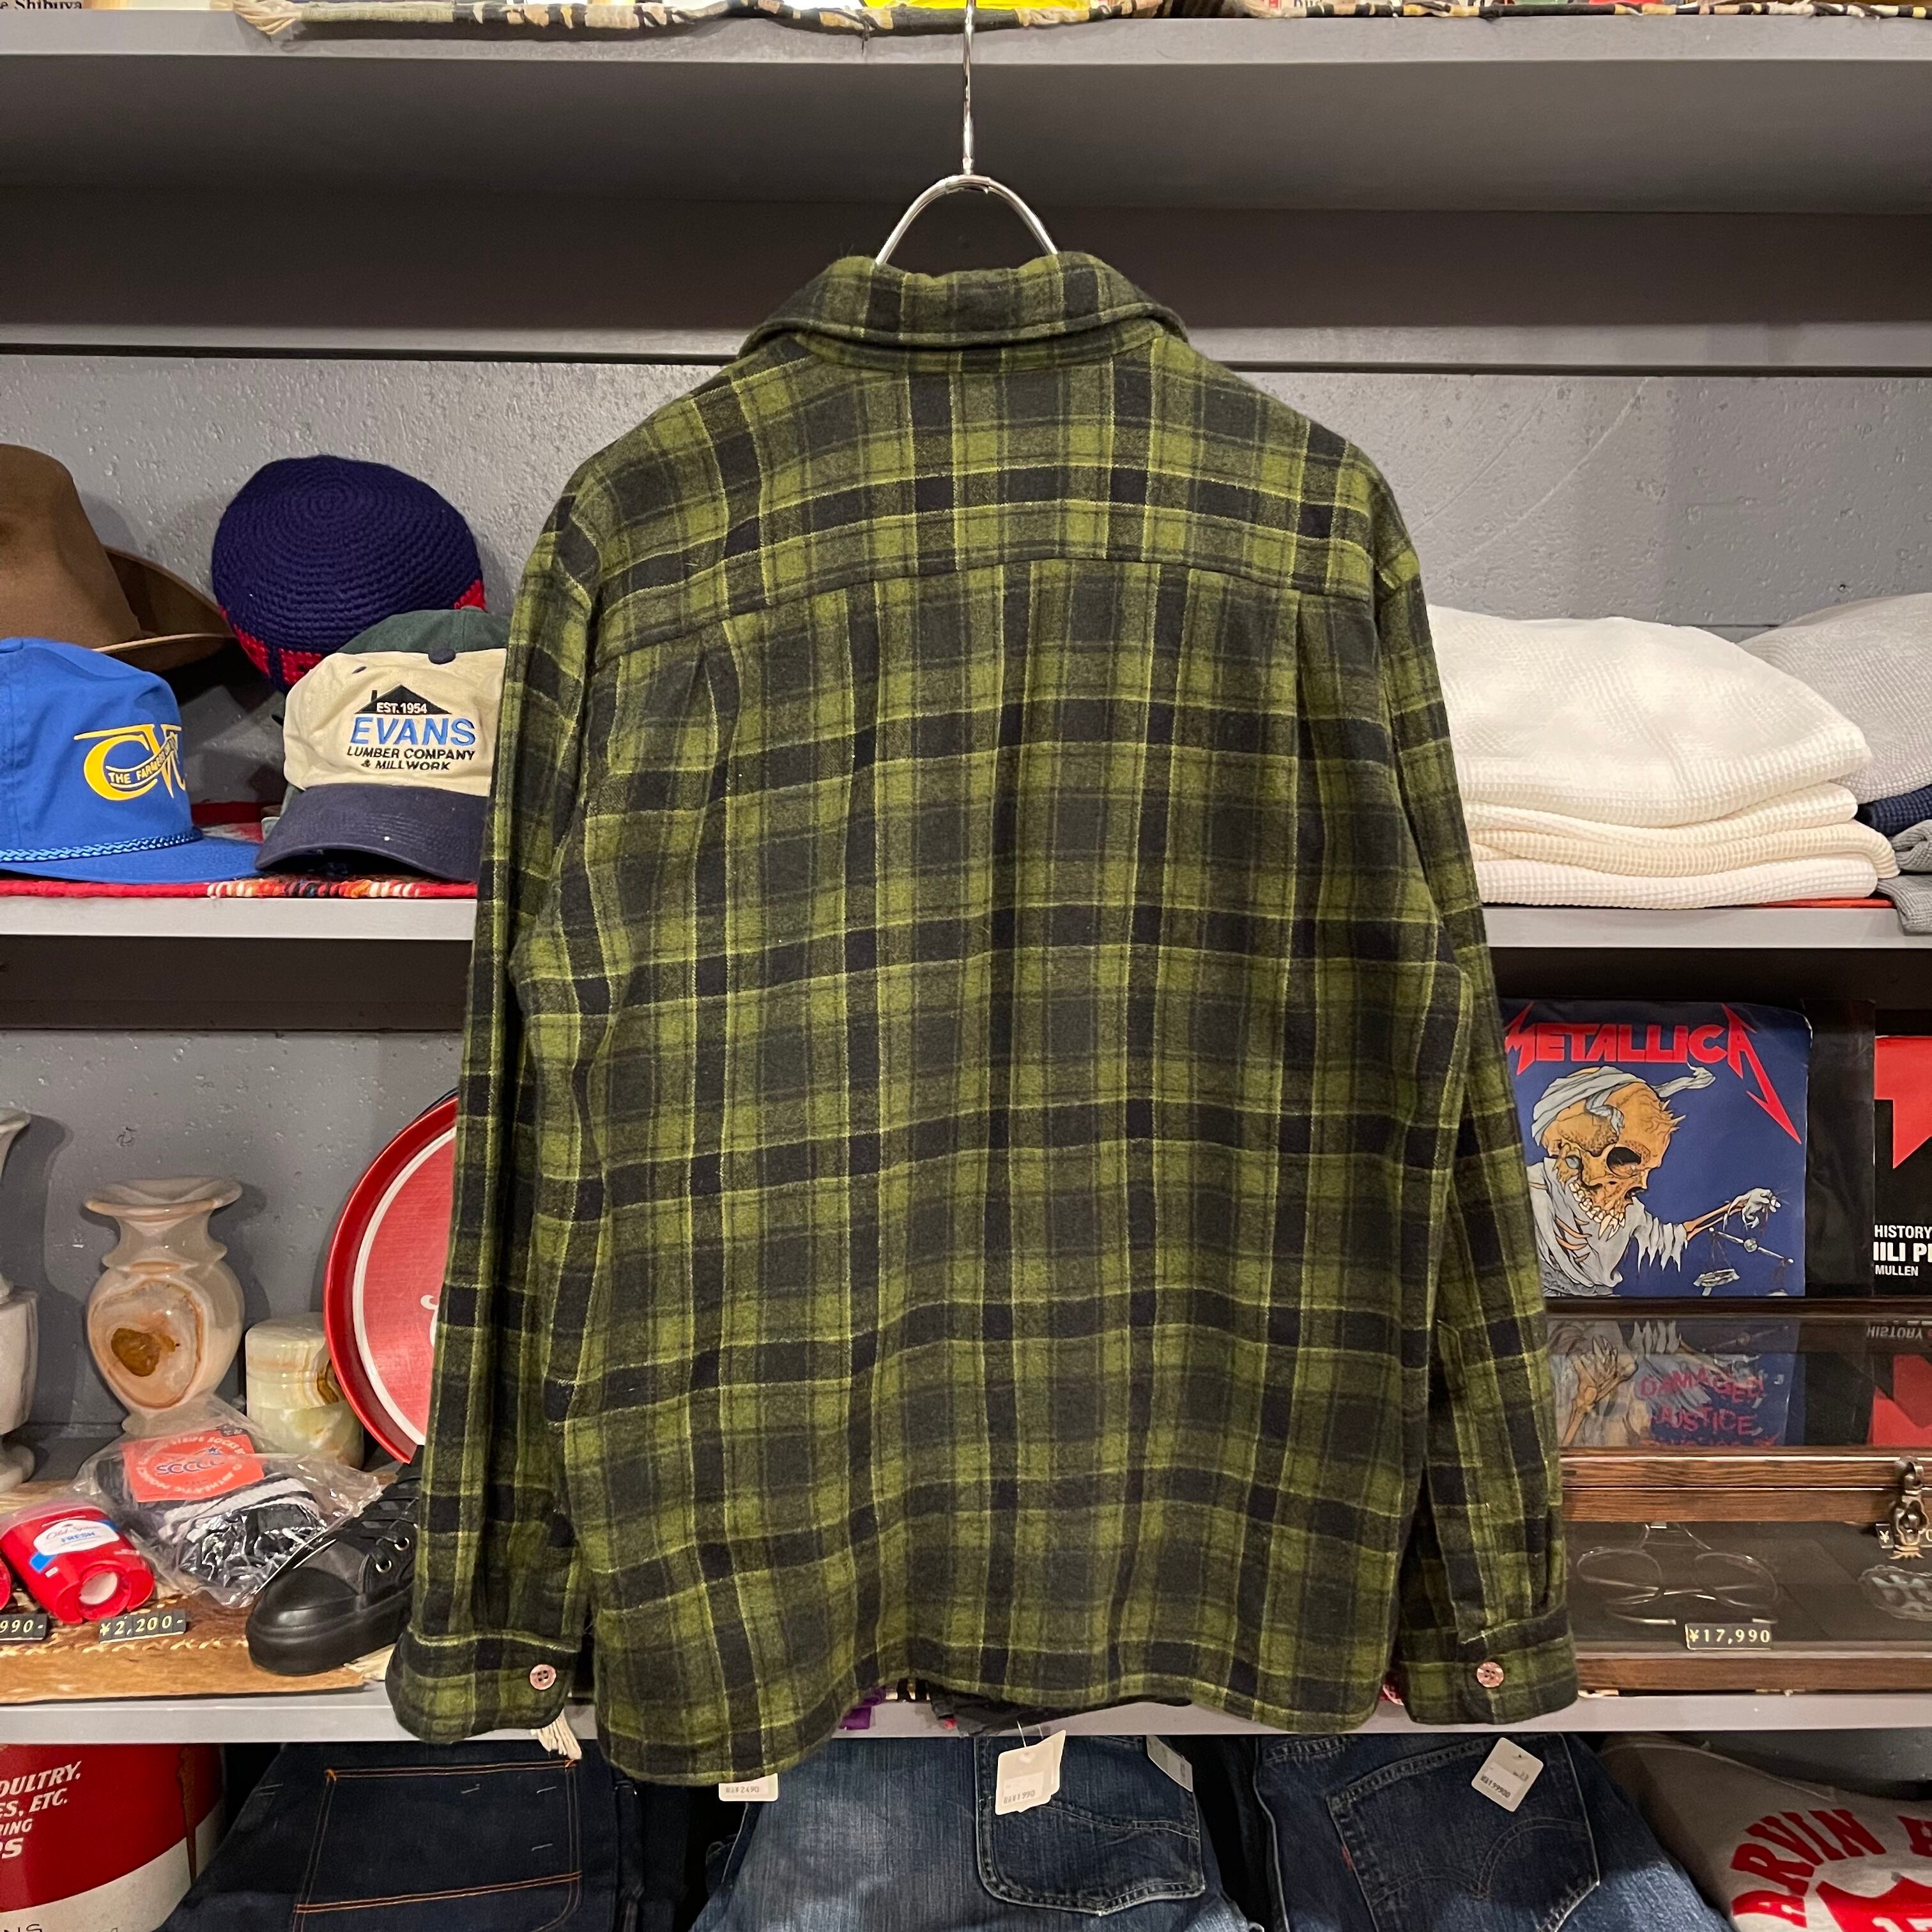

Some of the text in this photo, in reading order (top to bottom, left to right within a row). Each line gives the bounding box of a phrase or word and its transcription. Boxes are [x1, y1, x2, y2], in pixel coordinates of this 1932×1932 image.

[350, 716, 476, 746] EVANS
[347, 746, 475, 760] LUMBER COMPANY
[361, 759, 450, 770] & MILLWORK
[108, 772, 131, 784] THE
[1505, 1002, 1802, 1145] METALLICA
[1874, 1225, 1932, 1239] HISTORY
[1875, 1264, 1919, 1276] MULLEN
[1689, 1629, 1770, 1644] ¥17,990
[29, 1788, 67, 1813] ETC.
